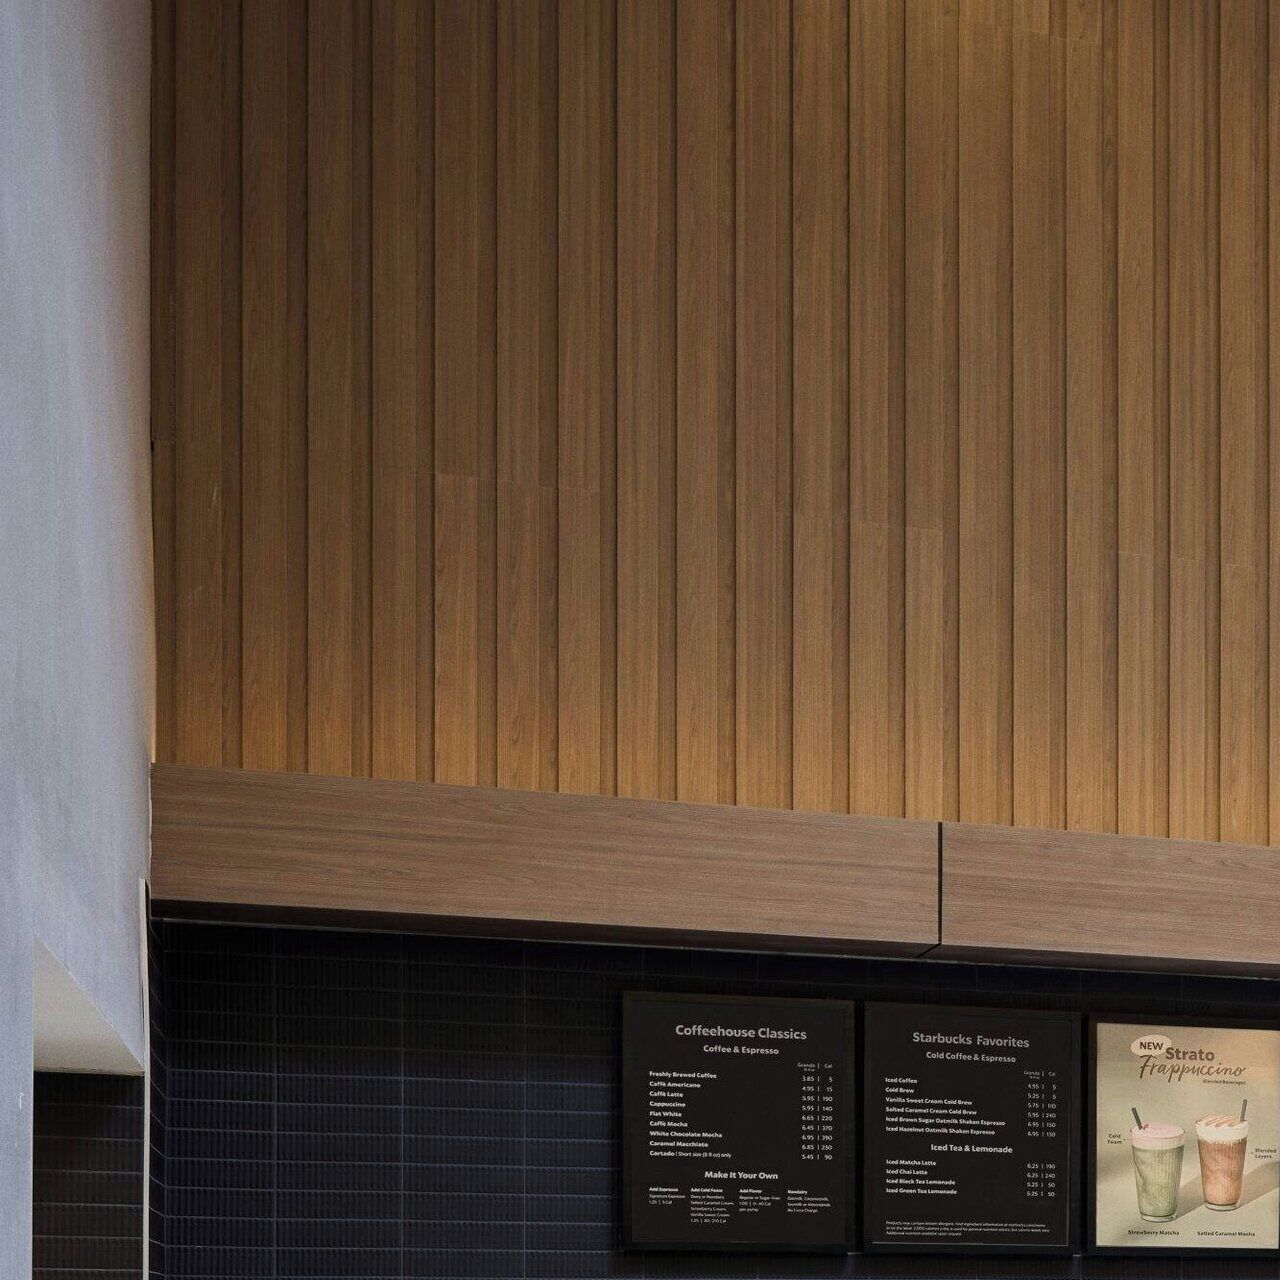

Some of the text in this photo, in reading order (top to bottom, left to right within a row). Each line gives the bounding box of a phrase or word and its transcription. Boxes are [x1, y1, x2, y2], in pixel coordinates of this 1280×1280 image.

[676, 1025, 807, 1040] Coffeehouse Classics
[913, 1032, 1030, 1048] Starbucks Favorites
[1140, 1042, 1163, 1050] NEW
[703, 1045, 732, 1053] Coffee
[741, 1046, 779, 1055] Espresso
[1165, 1047, 1215, 1061] Strato
[926, 1051, 944, 1059] Cold
[945, 1052, 972, 1060] Coffee
[981, 1054, 1016, 1063] Espresso
[1139, 1054, 1246, 1083] Frappuccino
[972, 1145, 1013, 1153] Lemonade
